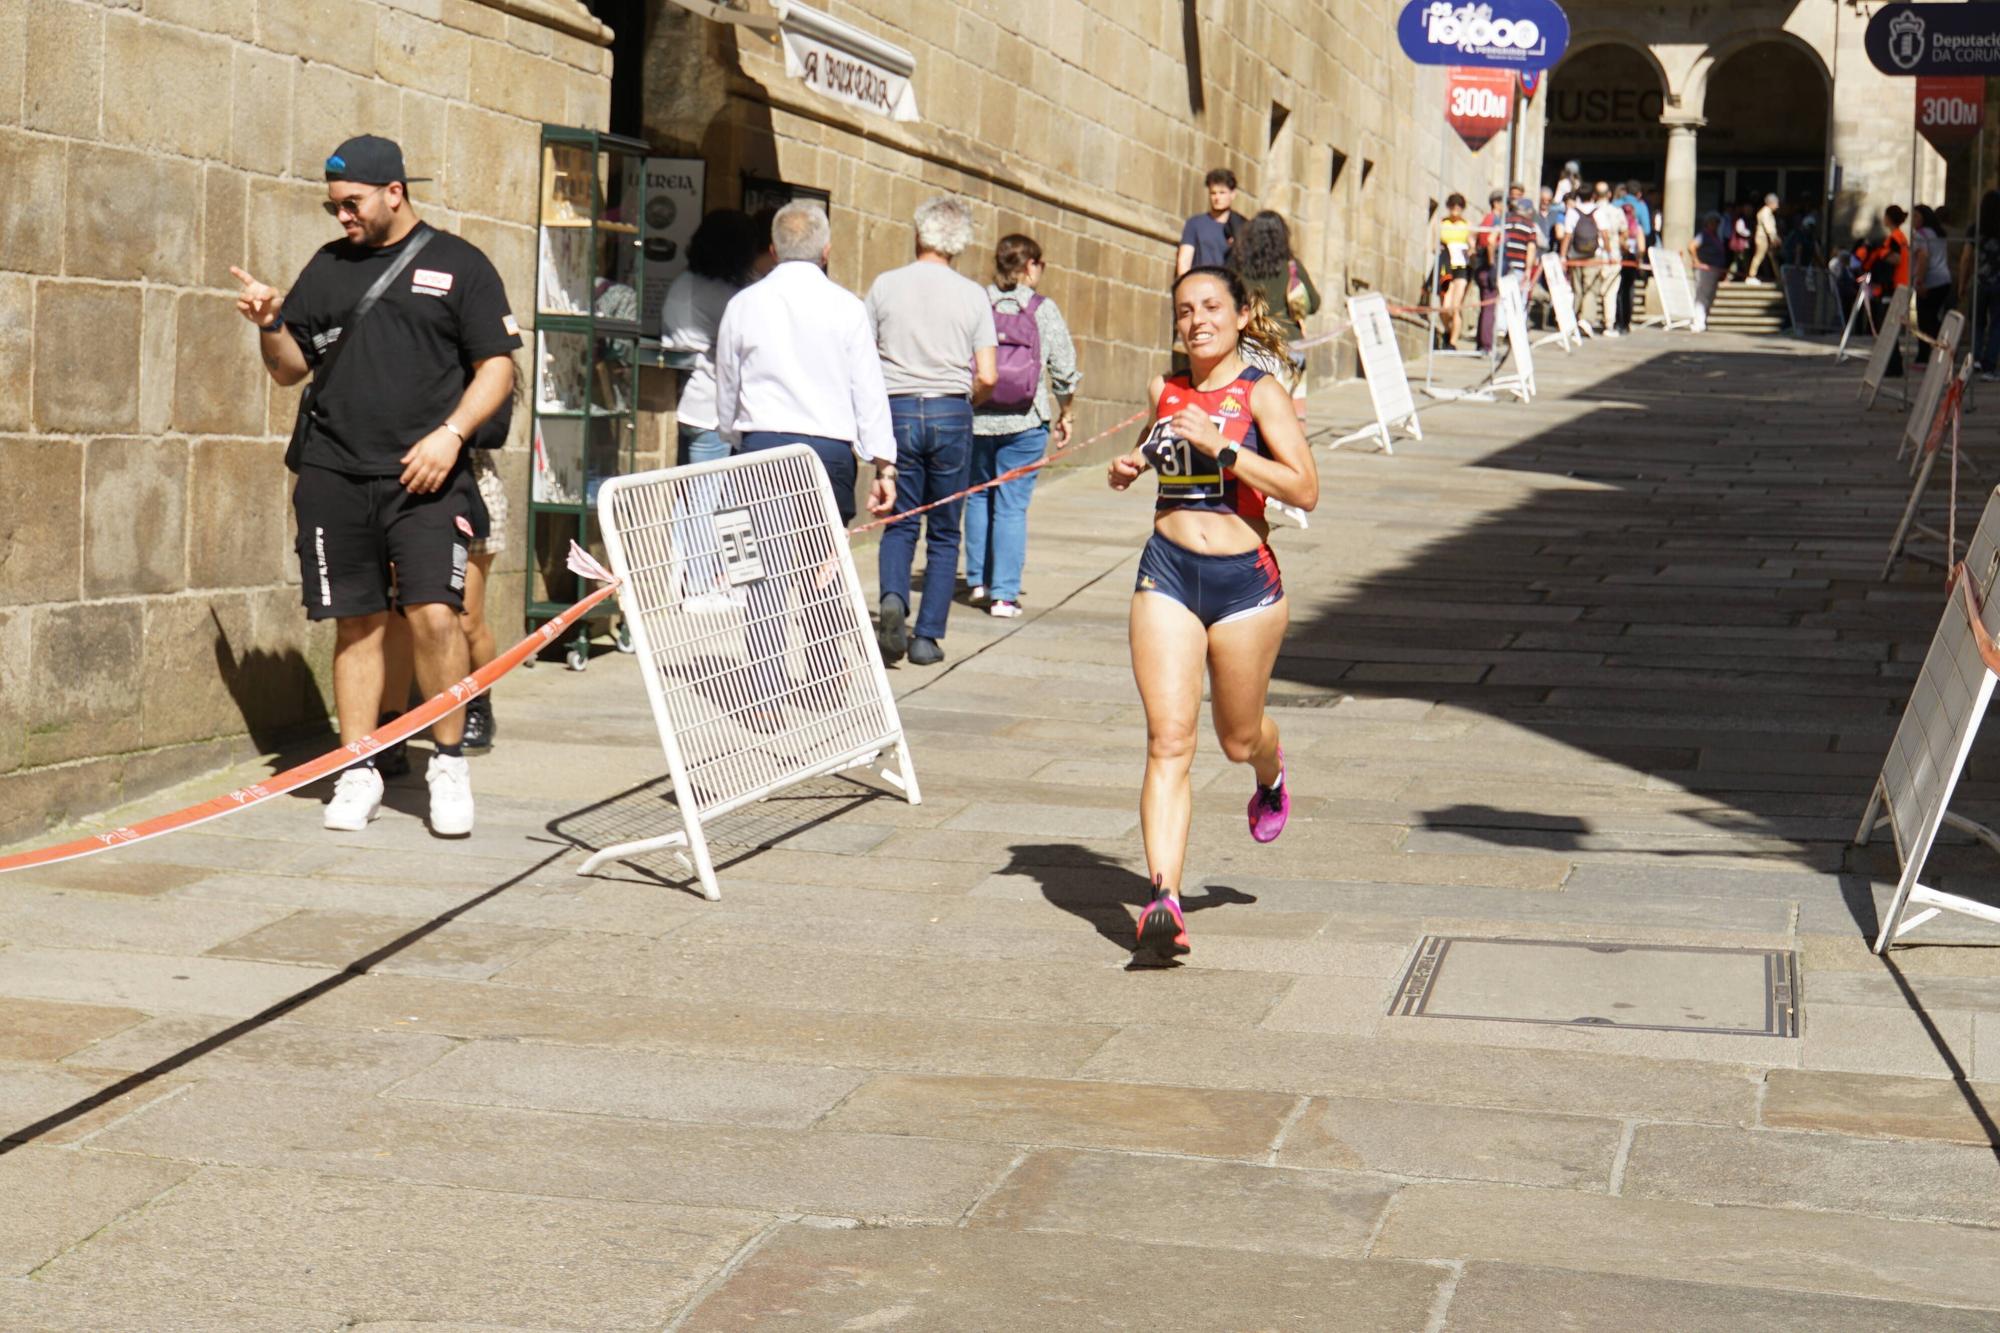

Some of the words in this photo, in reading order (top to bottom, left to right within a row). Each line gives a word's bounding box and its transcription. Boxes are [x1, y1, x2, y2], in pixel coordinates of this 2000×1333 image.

[804, 51, 818, 82] A
[1931, 47, 1951, 62] DA
[1451, 87, 1507, 119] 300M
[1922, 97, 1978, 125] 300M
[1157, 439, 1193, 477] 31
